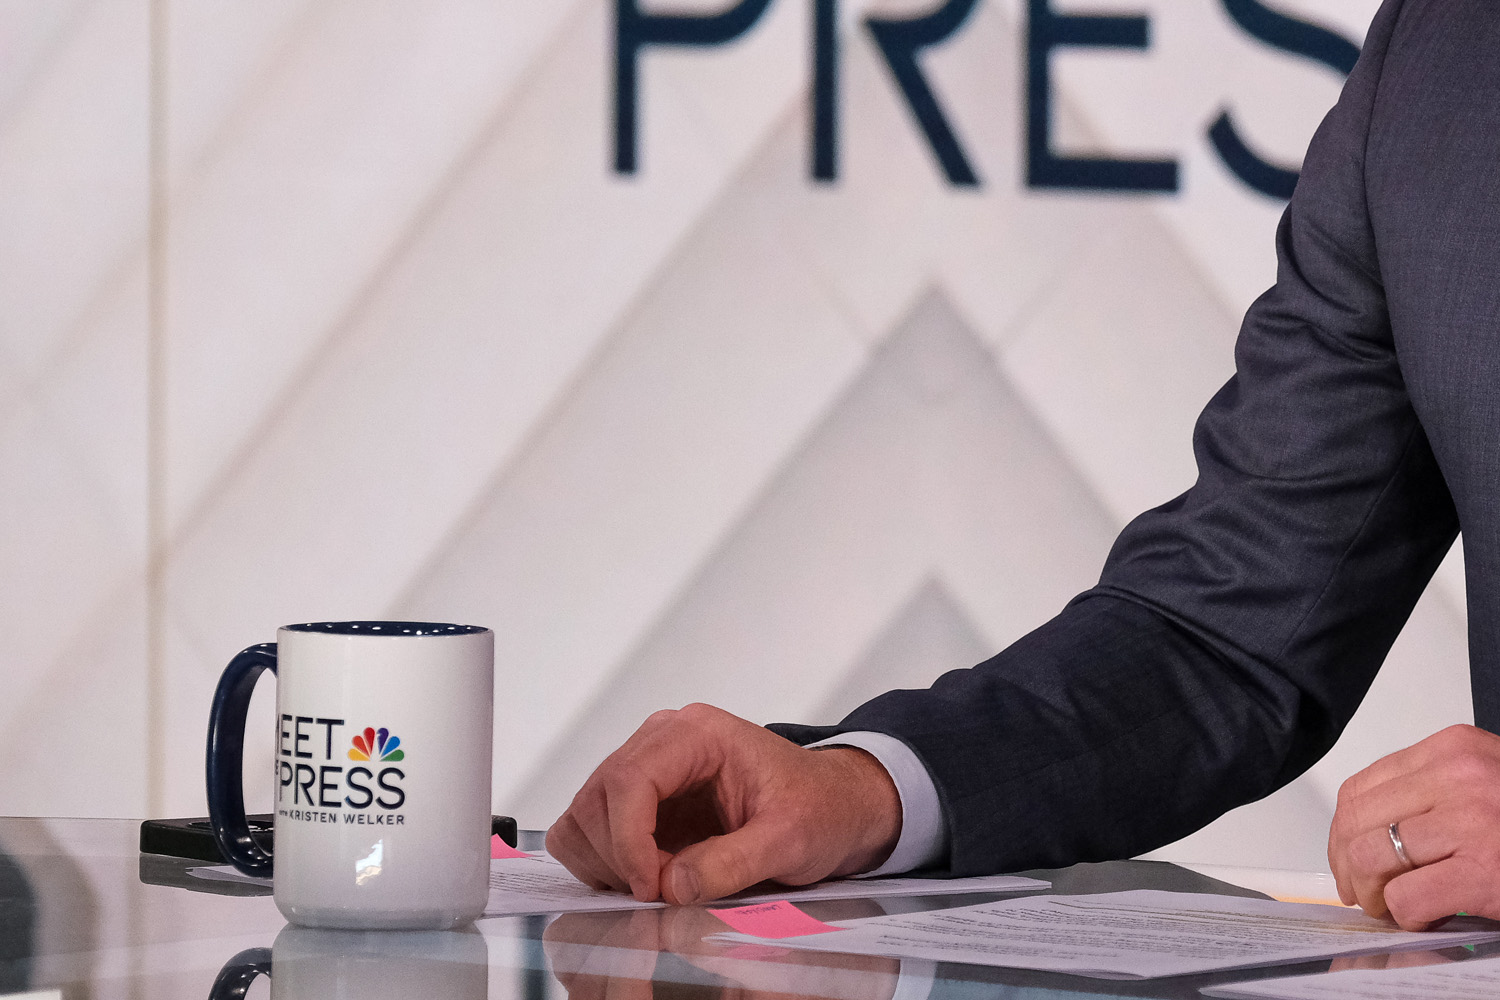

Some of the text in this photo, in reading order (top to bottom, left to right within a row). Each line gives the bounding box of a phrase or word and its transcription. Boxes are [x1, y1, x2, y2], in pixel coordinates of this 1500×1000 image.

[276, 713, 344, 760] EET
[279, 760, 406, 810] PRESS
[289, 810, 337, 824] KRISTEN
[343, 813, 405, 826] WELKER
